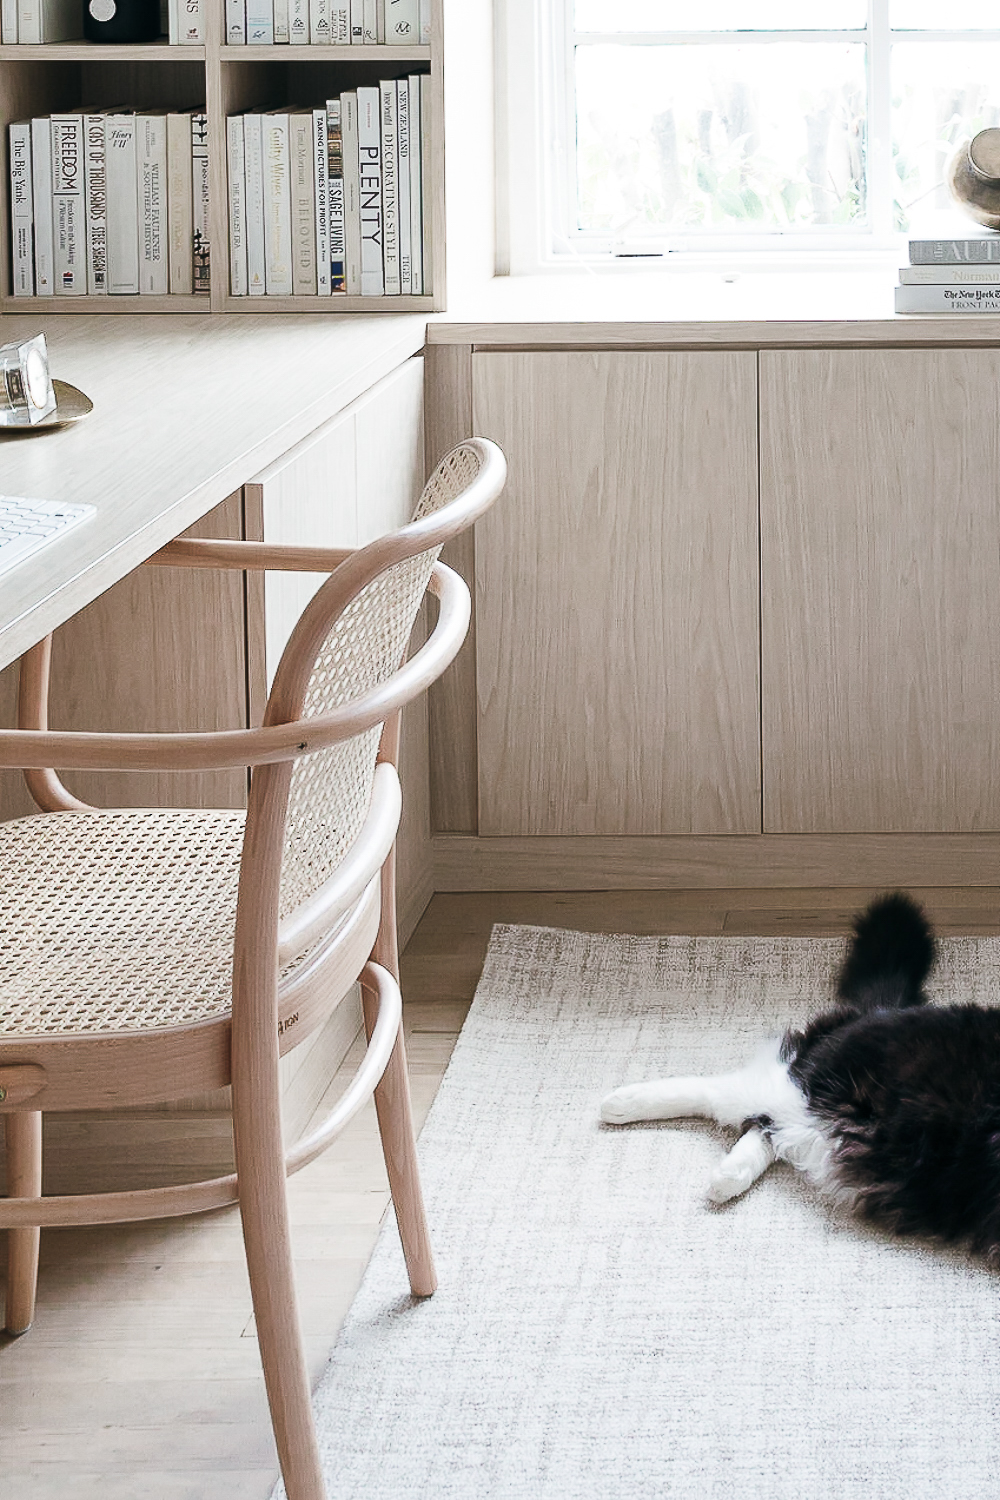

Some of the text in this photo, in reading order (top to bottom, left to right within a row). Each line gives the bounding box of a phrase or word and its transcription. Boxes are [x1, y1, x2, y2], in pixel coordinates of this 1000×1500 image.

[61, 126, 77, 190] FREEDOM
[88, 127, 104, 149] CAST
[89, 152, 104, 164] OF
[12, 138, 26, 204] The Big Yank
[89, 168, 105, 221] THOUSANDS
[360, 147, 380, 246] PLENTY
[329, 190, 344, 254] SAGE LIVING
